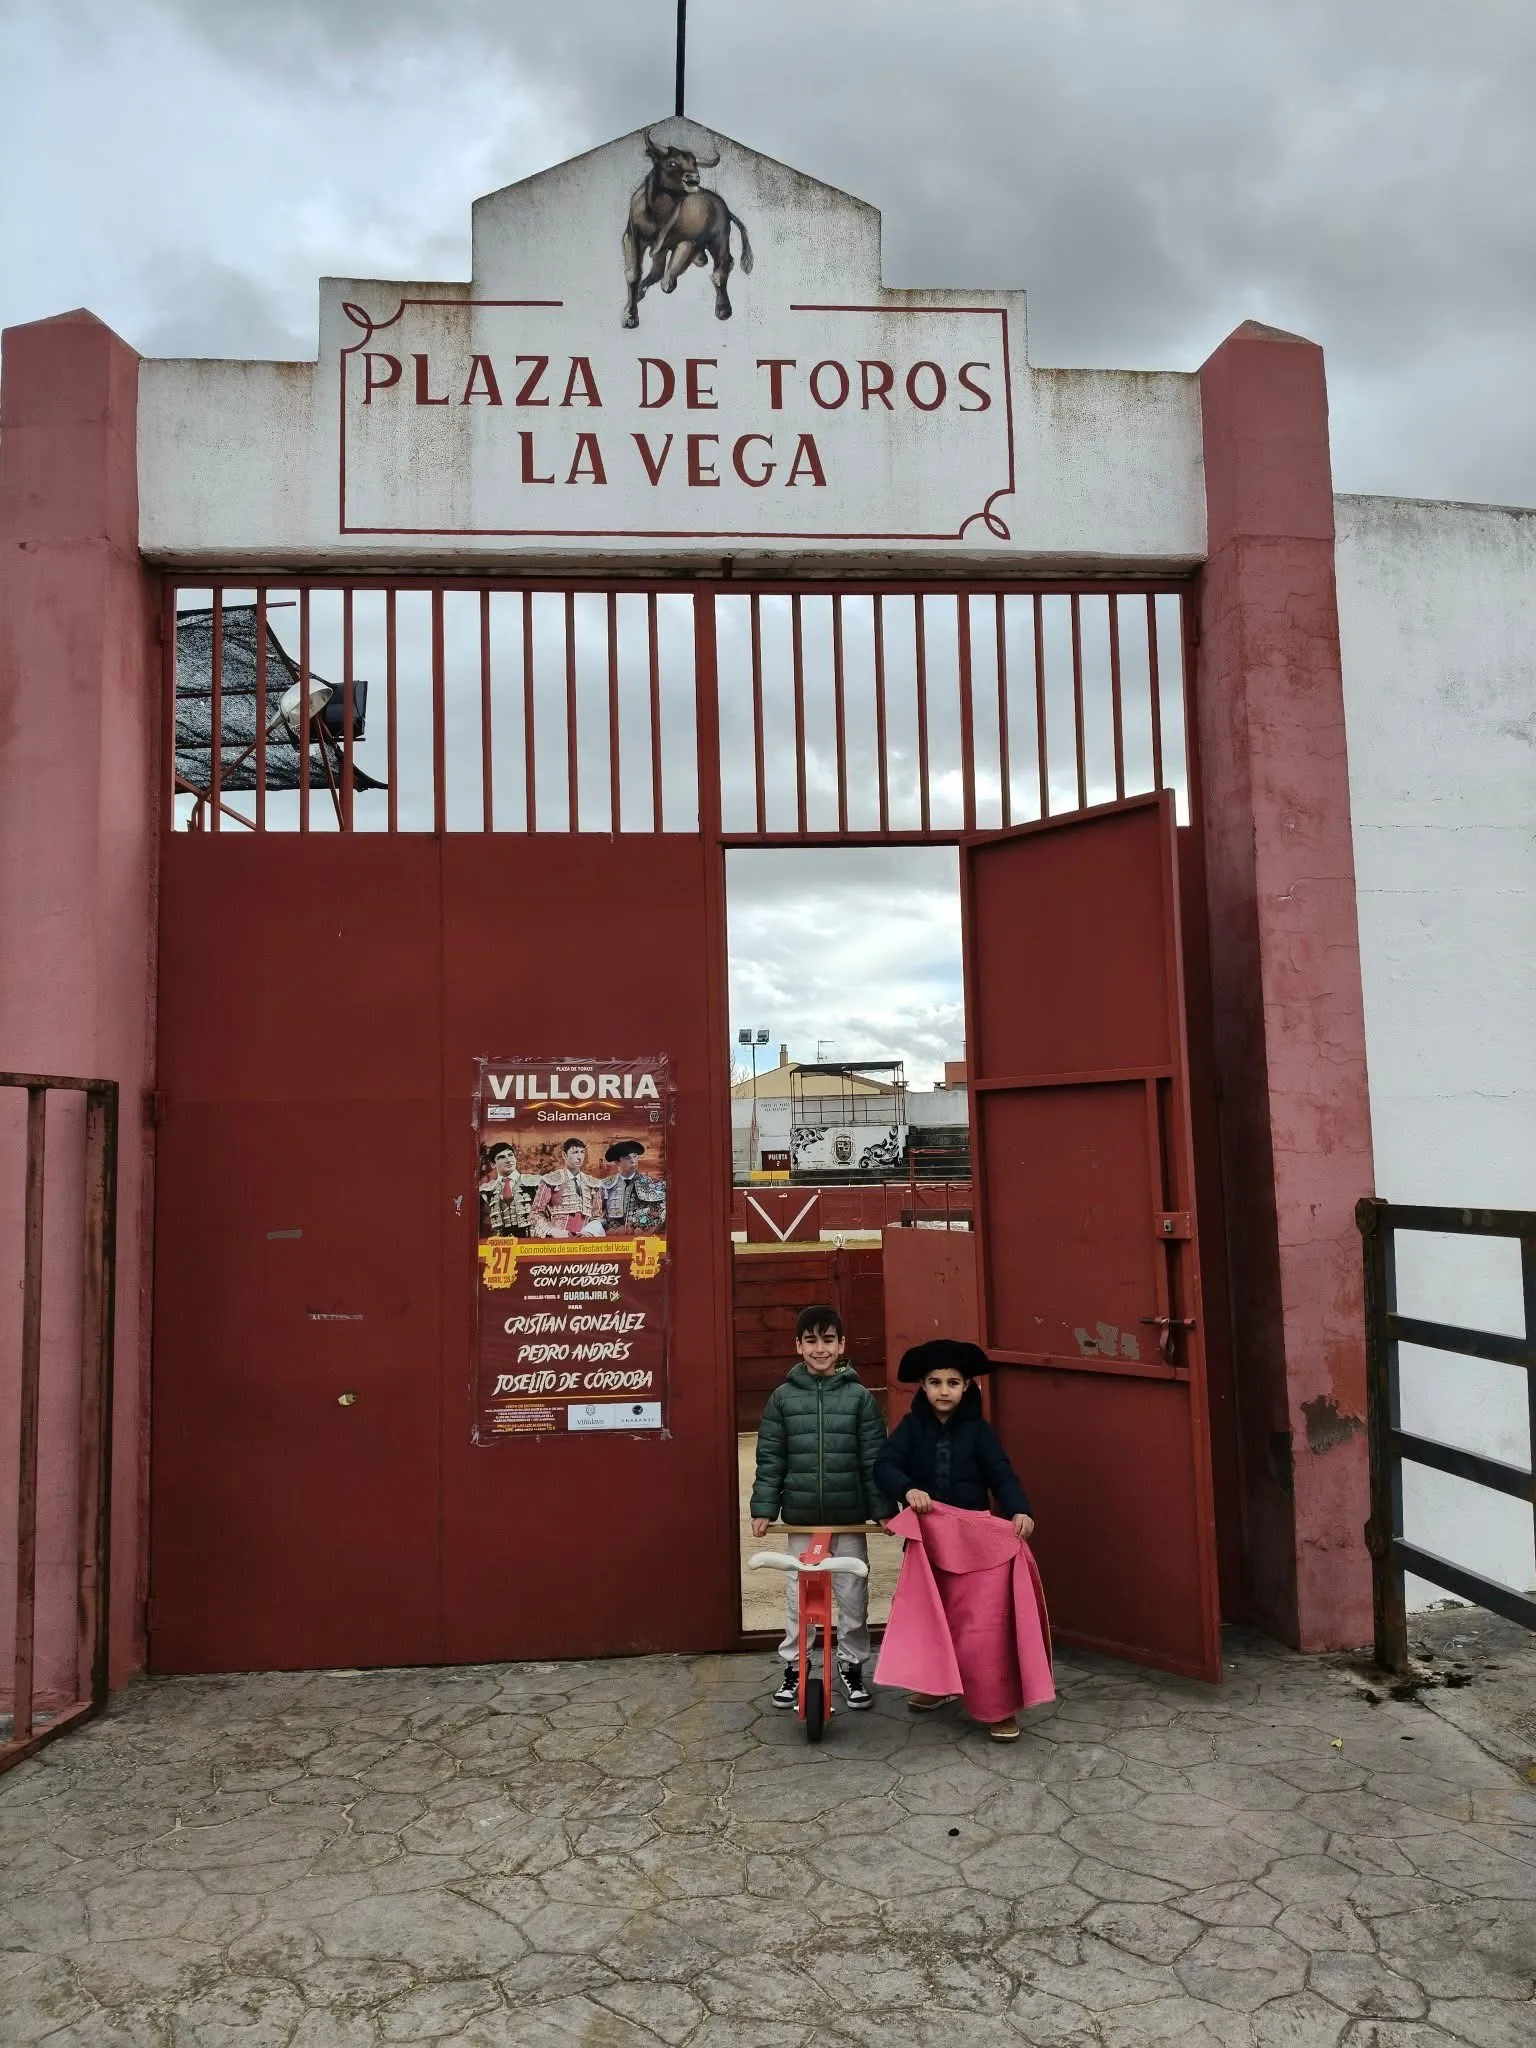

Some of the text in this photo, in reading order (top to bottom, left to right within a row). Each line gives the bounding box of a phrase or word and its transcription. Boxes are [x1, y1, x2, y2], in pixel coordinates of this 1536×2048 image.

[361, 352, 992, 412] PLAZA DE TOROS
[517, 431, 827, 488] LA VEGA
[488, 1074, 660, 1099] VILLORIA
[537, 1110, 611, 1121] Salamanca
[492, 1247, 511, 1274] 27
[520, 1246, 532, 1254] Con
[533, 1245, 556, 1254] motivo
[557, 1245, 566, 1253] de
[566, 1245, 579, 1253] sus
[580, 1244, 603, 1253] Fiestas
[604, 1243, 613, 1252] del
[529, 1263, 619, 1276] GRAN NOVILLADA
[533, 1275, 621, 1287] CON PICADORES
[563, 1291, 608, 1300] GUADAJIRA
[504, 1311, 646, 1336] CRISTIAN GONZÁLEZ
[516, 1338, 634, 1364] PEDRO ANDRÉS
[491, 1368, 653, 1396] JOSELITO DE CÓRDOBA
